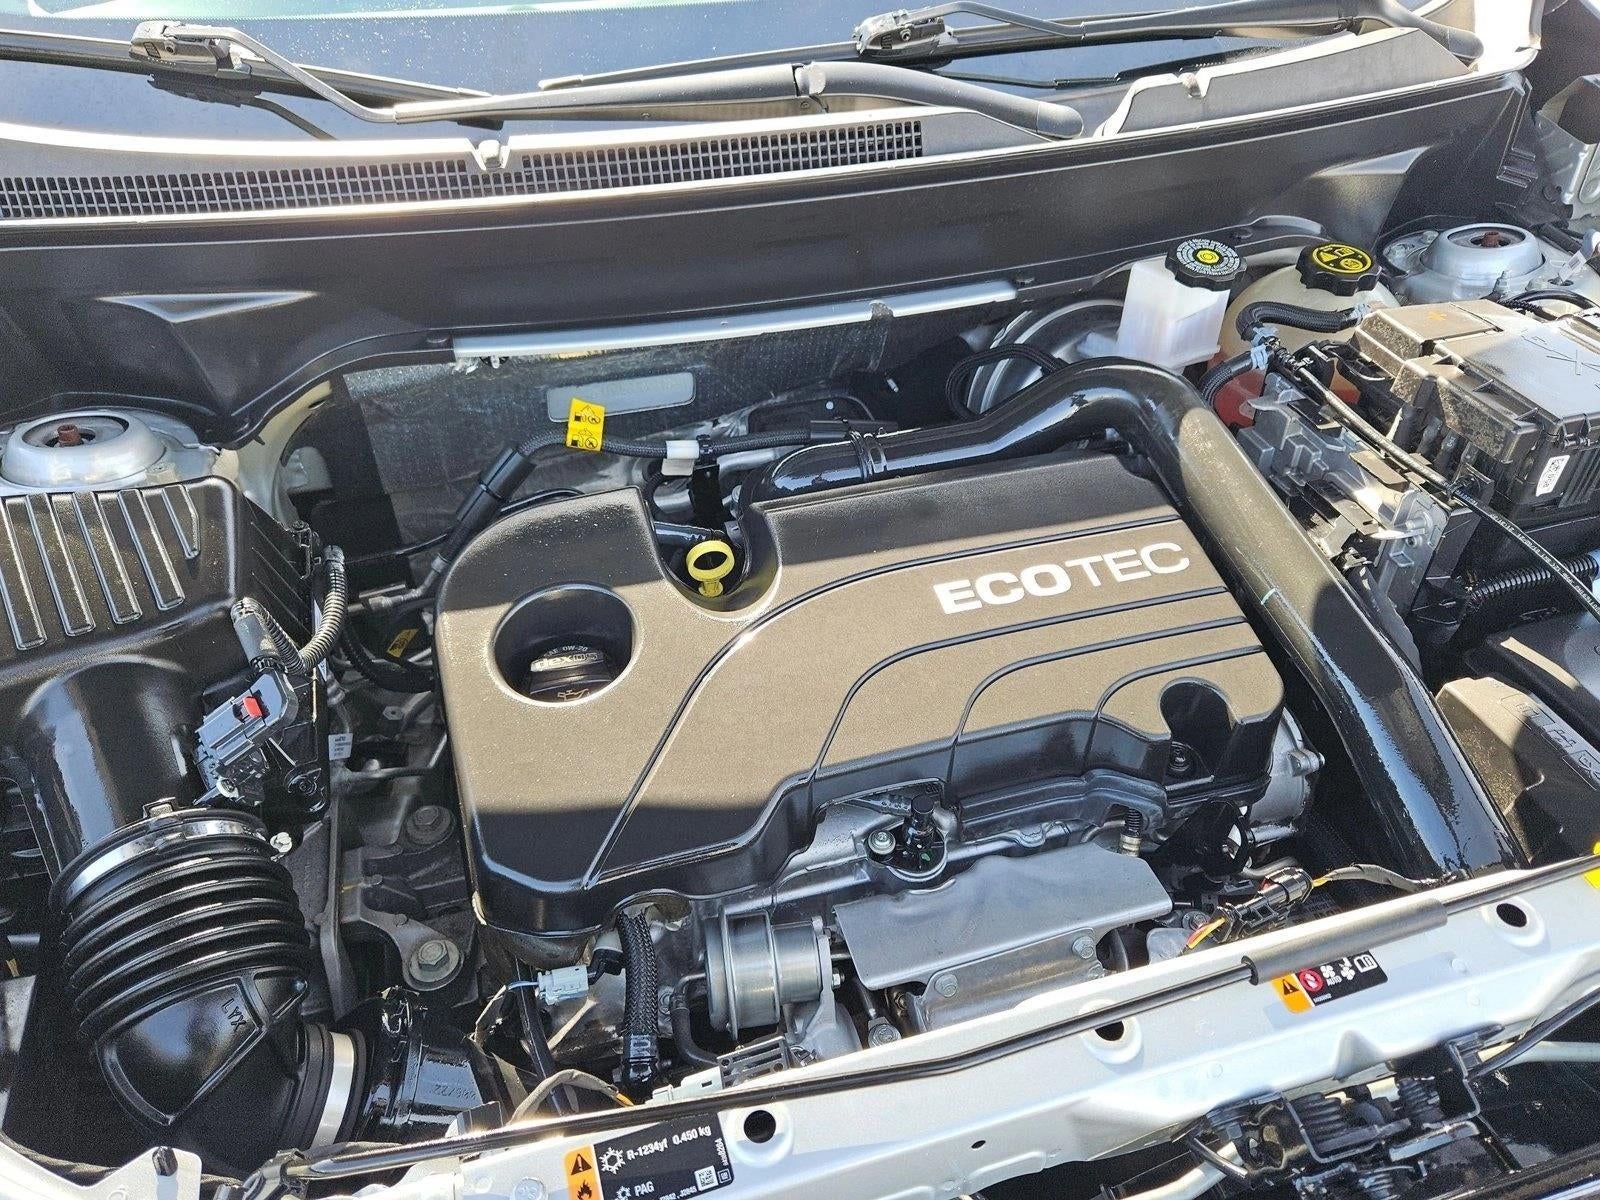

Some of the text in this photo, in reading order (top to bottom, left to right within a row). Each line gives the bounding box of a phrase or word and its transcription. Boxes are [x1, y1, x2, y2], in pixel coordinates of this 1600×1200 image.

[933, 542, 1190, 615] ECOTEC
[535, 652, 598, 669] dexos
[562, 645, 588, 653] 0W-20
[221, 997, 247, 1033] LYX
[626, 1125, 712, 1160] R-1234yf 0.450 kg
[634, 1180, 655, 1197] PAG
